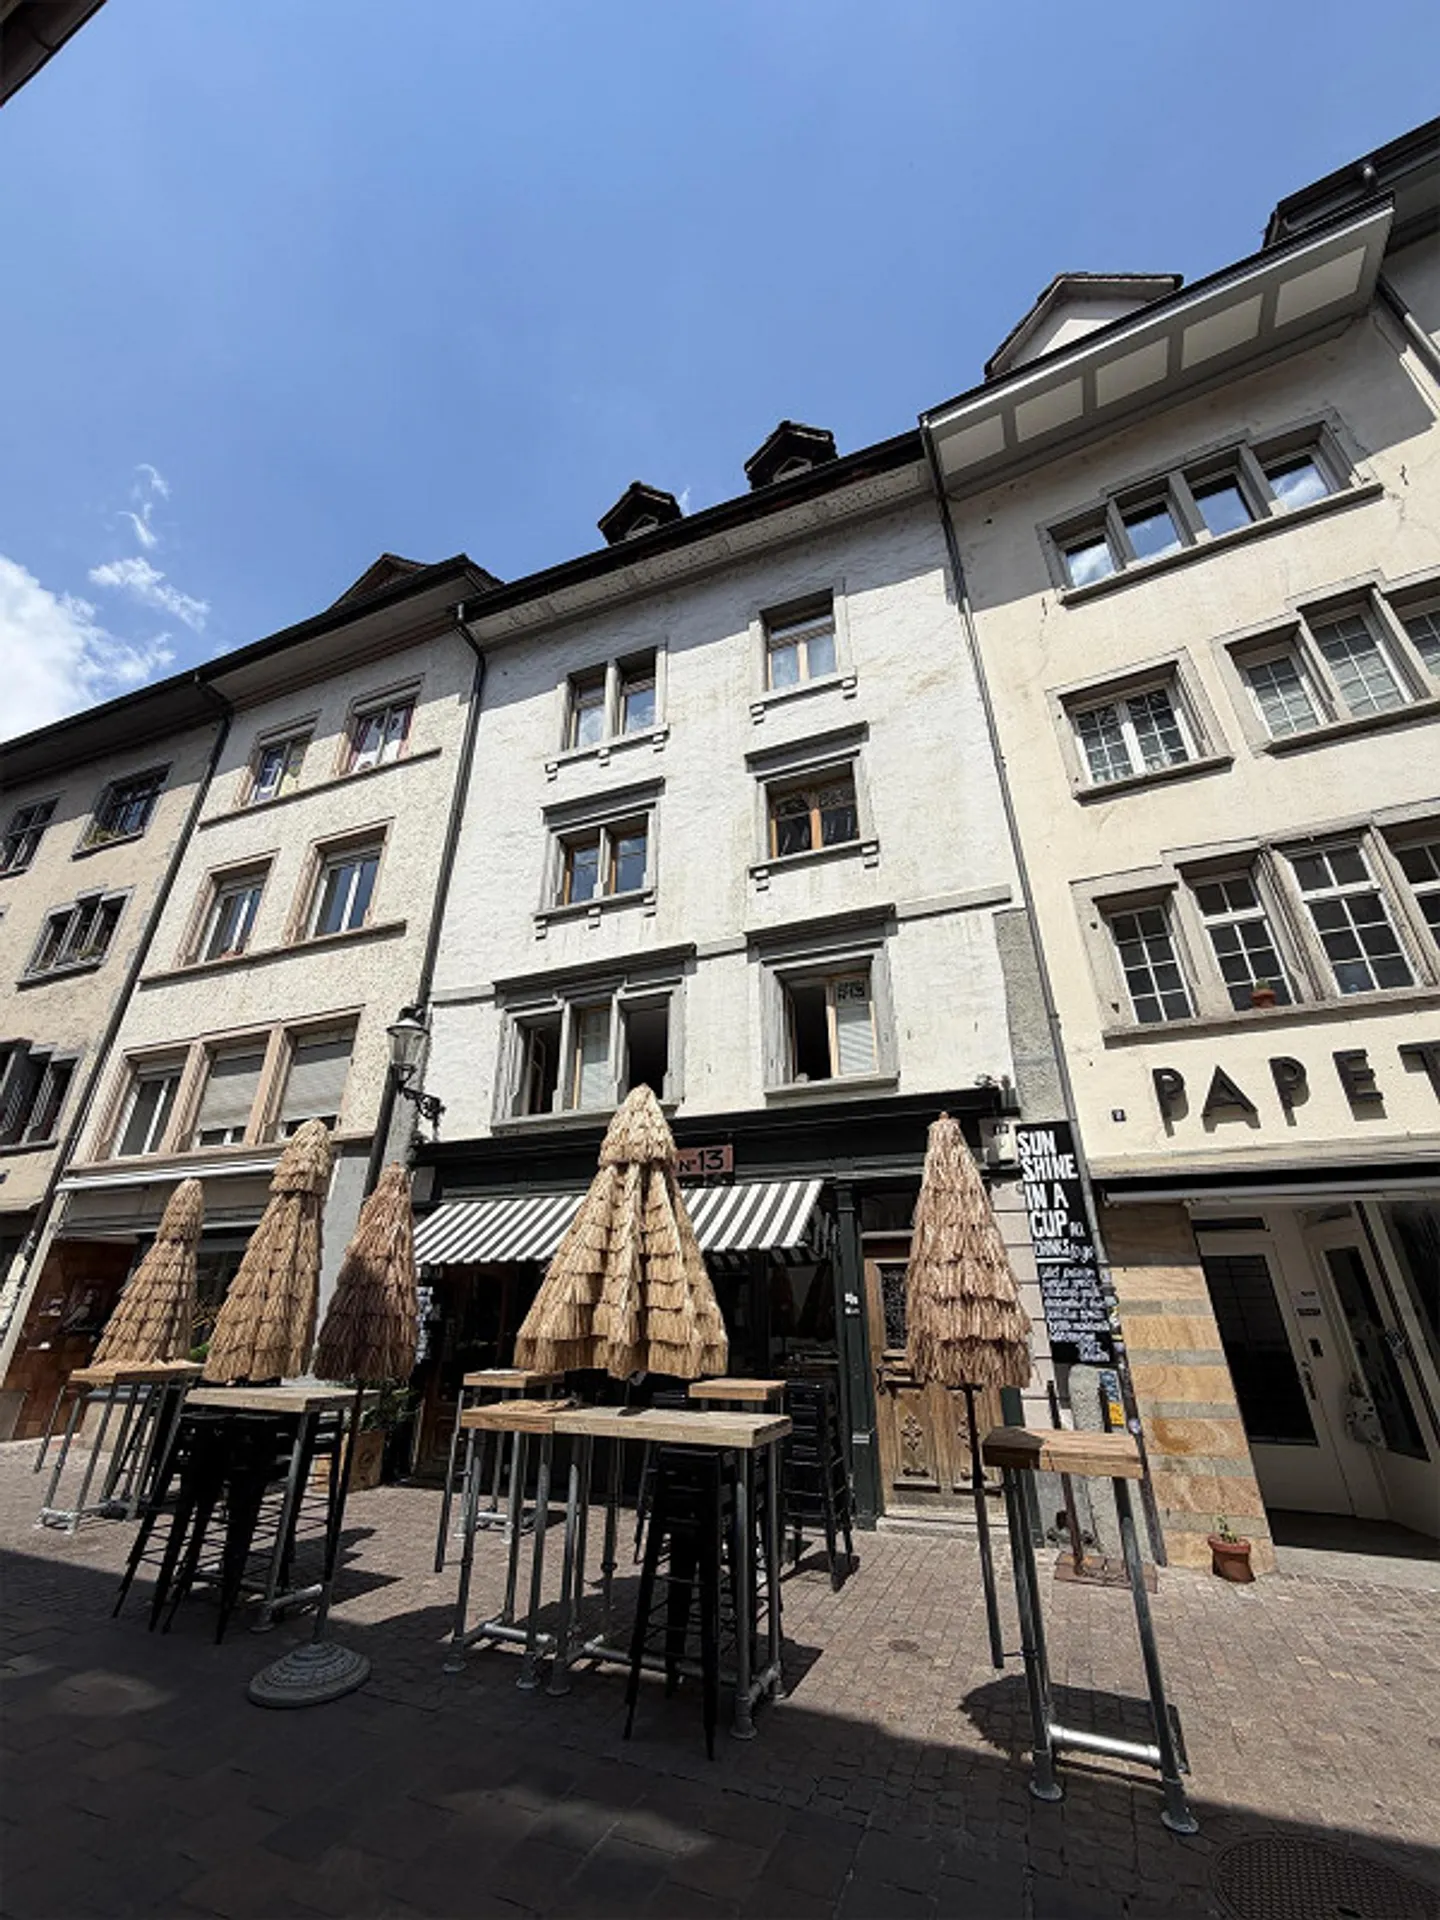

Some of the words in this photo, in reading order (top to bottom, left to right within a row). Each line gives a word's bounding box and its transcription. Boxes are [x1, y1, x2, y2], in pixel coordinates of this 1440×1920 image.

[1152, 1040, 1440, 1135] PAPET
[1017, 1130, 1057, 1156] SUN
[1021, 1154, 1079, 1182] SHINE
[1025, 1183, 1048, 1210] IN
[1054, 1182, 1069, 1208] A
[1030, 1210, 1068, 1238] CUP
